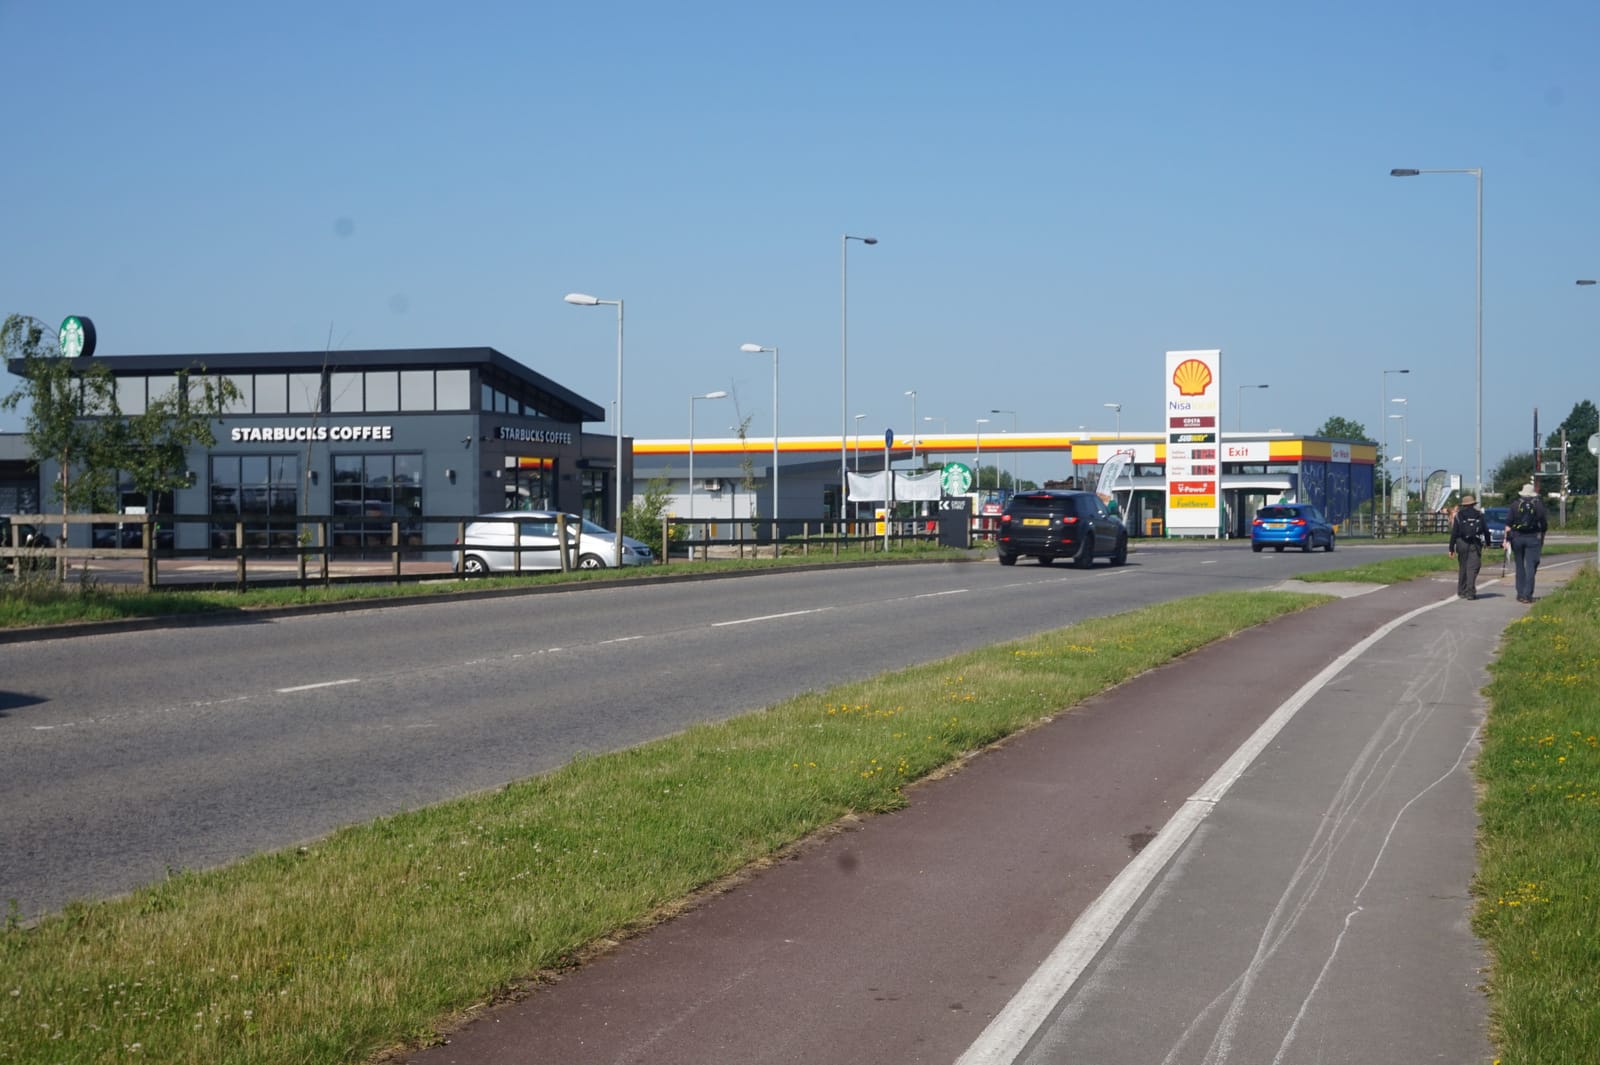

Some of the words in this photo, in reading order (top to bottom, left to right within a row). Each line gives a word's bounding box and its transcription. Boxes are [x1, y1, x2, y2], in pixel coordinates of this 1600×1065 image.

[1169, 400, 1191, 410] Nisa
[231, 426, 327, 441] STARBUCKS
[329, 425, 392, 440] COFFEE
[500, 426, 545, 442] STARBUCKS
[545, 431, 572, 445] COFFEE
[1228, 447, 1249, 457] Exit
